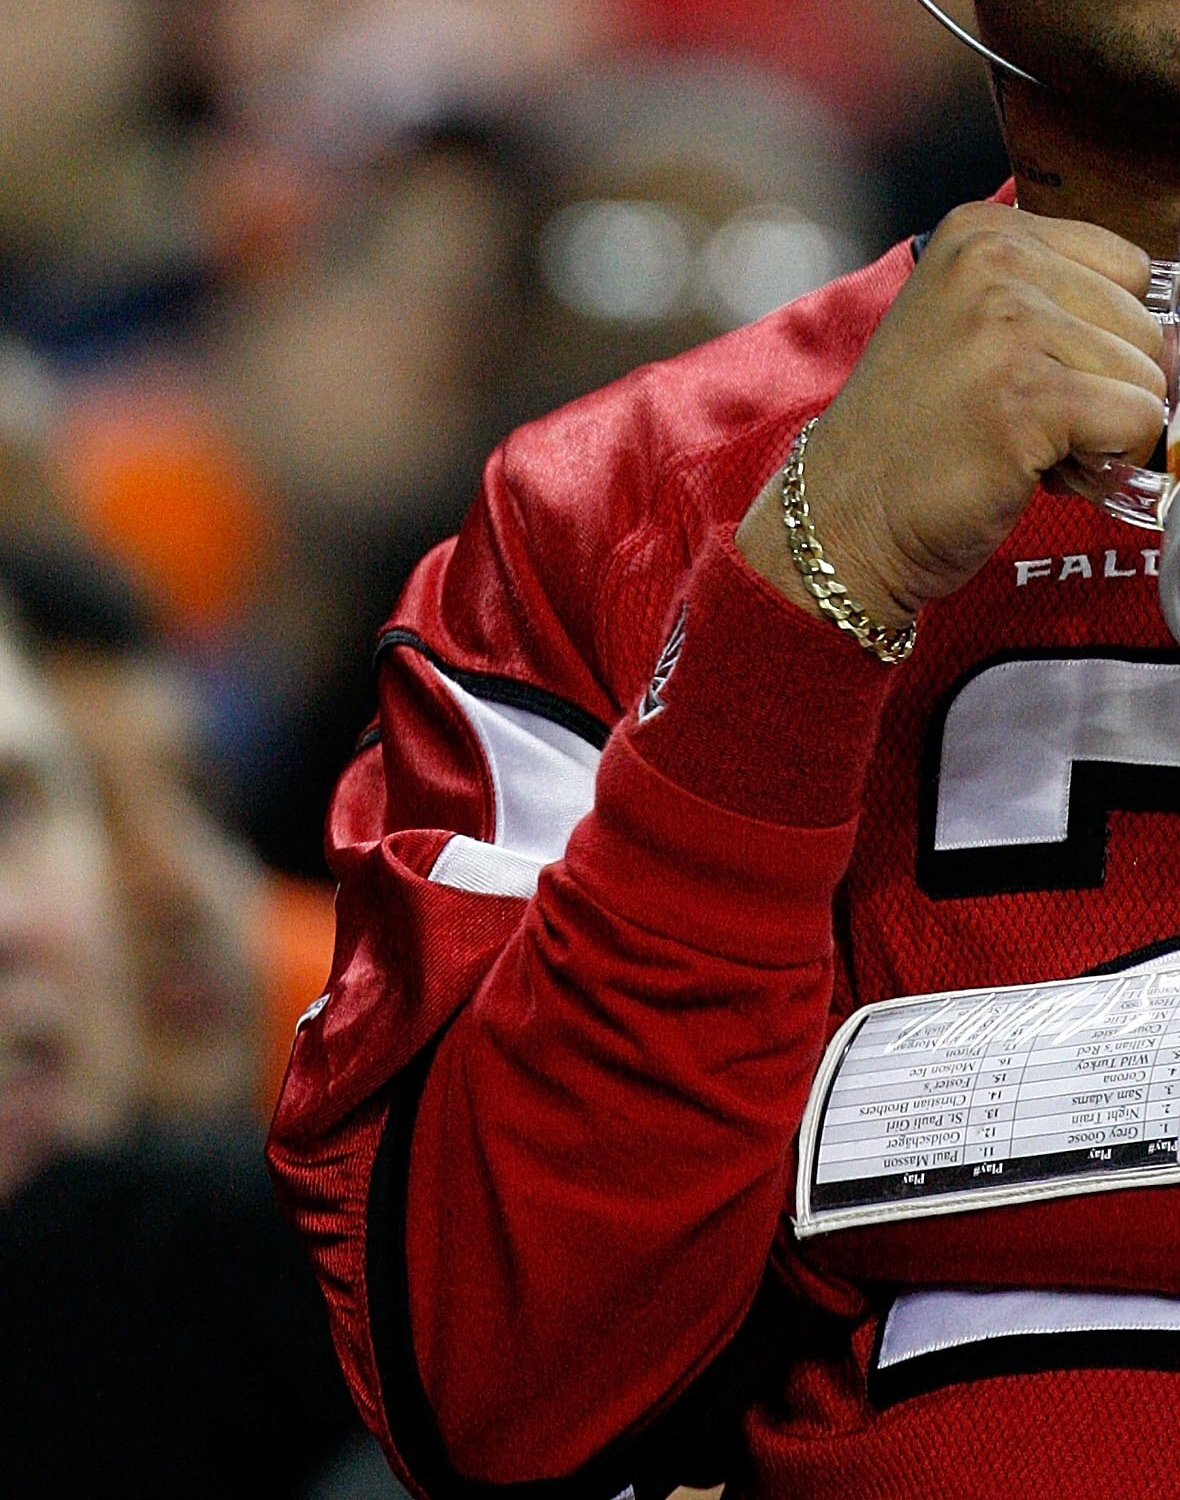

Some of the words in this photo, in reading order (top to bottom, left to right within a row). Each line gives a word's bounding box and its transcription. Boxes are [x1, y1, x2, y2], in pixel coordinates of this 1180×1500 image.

[1091, 1024, 1161, 1040] Courisier
[1077, 1045, 1100, 1055] Red
[1104, 1038, 1156, 1052] Killian's
[1075, 1058, 1116, 1071] Turkey
[1121, 1054, 1149, 1068] Wild
[909, 1067, 927, 1078] Ice
[931, 1061, 976, 1075] Molson
[1168, 1067, 1177, 1076] 4.
[992, 1073, 1007, 1083] 15.
[1103, 1071, 1146, 1083] Corona
[923, 1078, 970, 1092] Foster's
[1164, 1084, 1174, 1095] 3.
[988, 1090, 1002, 1100] 14.
[1072, 1091, 1113, 1105] Adams
[1117, 1088, 1143, 1101] Sam
[913, 1095, 966, 1111] Christian
[1161, 1104, 1171, 1114] 2.
[860, 1102, 909, 1117] Brothers
[984, 1108, 999, 1118] 13.
[1107, 1105, 1140, 1119] Night
[914, 1115, 943, 1127] Pauli
[948, 1112, 963, 1123] St.
[1072, 1113, 1102, 1125] Train
[886, 1119, 910, 1132] Girl
[1160, 1123, 1168, 1132] 1.
[981, 1127, 997, 1137] 12.
[1109, 1125, 1138, 1140] Grey
[1067, 1132, 1106, 1145] Goose
[979, 1147, 994, 1157] 11.
[1148, 1140, 1178, 1153] Play#
[933, 1151, 958, 1163] Paul
[1087, 1148, 1112, 1160] Play
[884, 1154, 929, 1169] Masson
[973, 1162, 1003, 1176] Play#
[902, 1173, 925, 1184] Play
